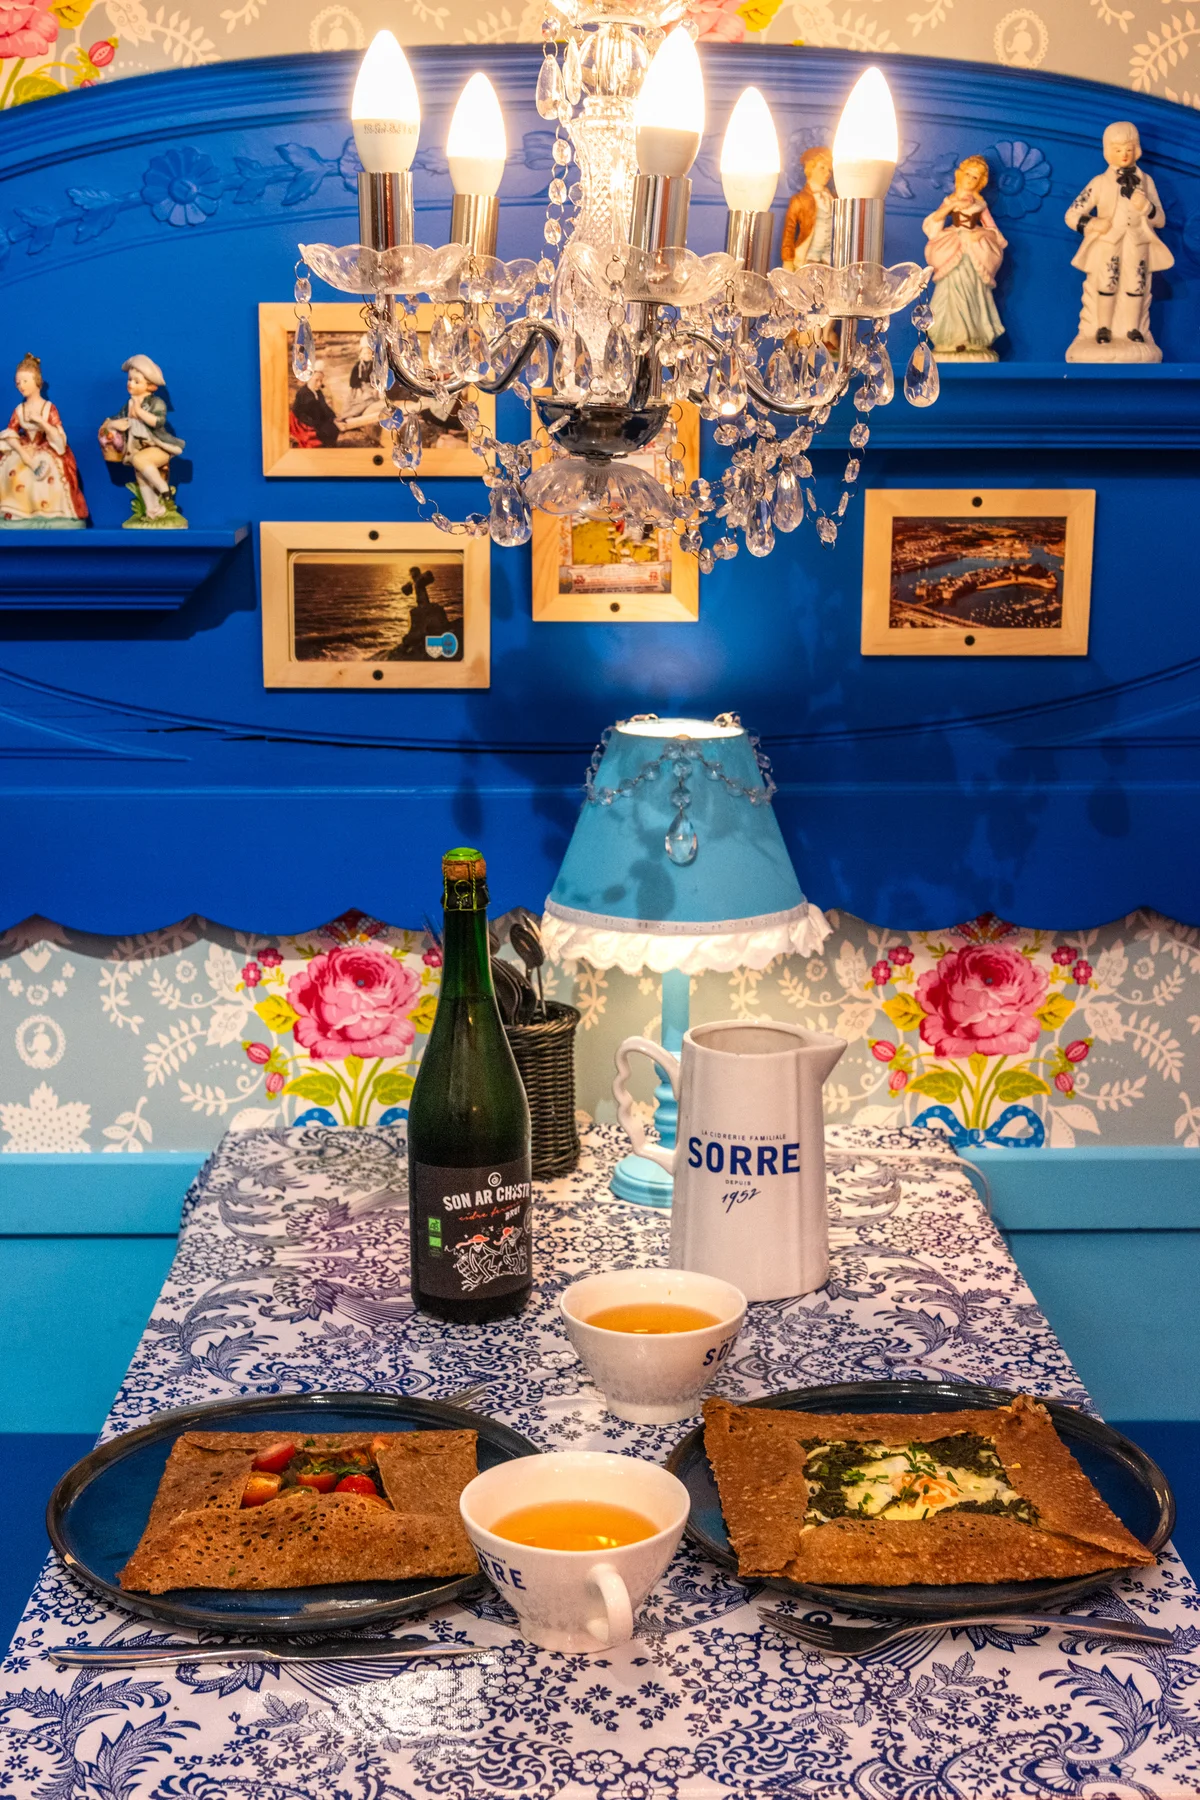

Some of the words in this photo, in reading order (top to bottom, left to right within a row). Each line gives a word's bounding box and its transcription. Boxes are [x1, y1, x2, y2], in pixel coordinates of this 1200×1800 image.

[709, 1131, 746, 1141] CIDRERIE
[749, 1133, 787, 1141] FAMILIALE
[687, 1136, 801, 1176] SORRE
[442, 1192, 472, 1212] SON
[475, 1189, 494, 1206] AR
[721, 1188, 762, 1214] 1952
[702, 1336, 738, 1367] SO
